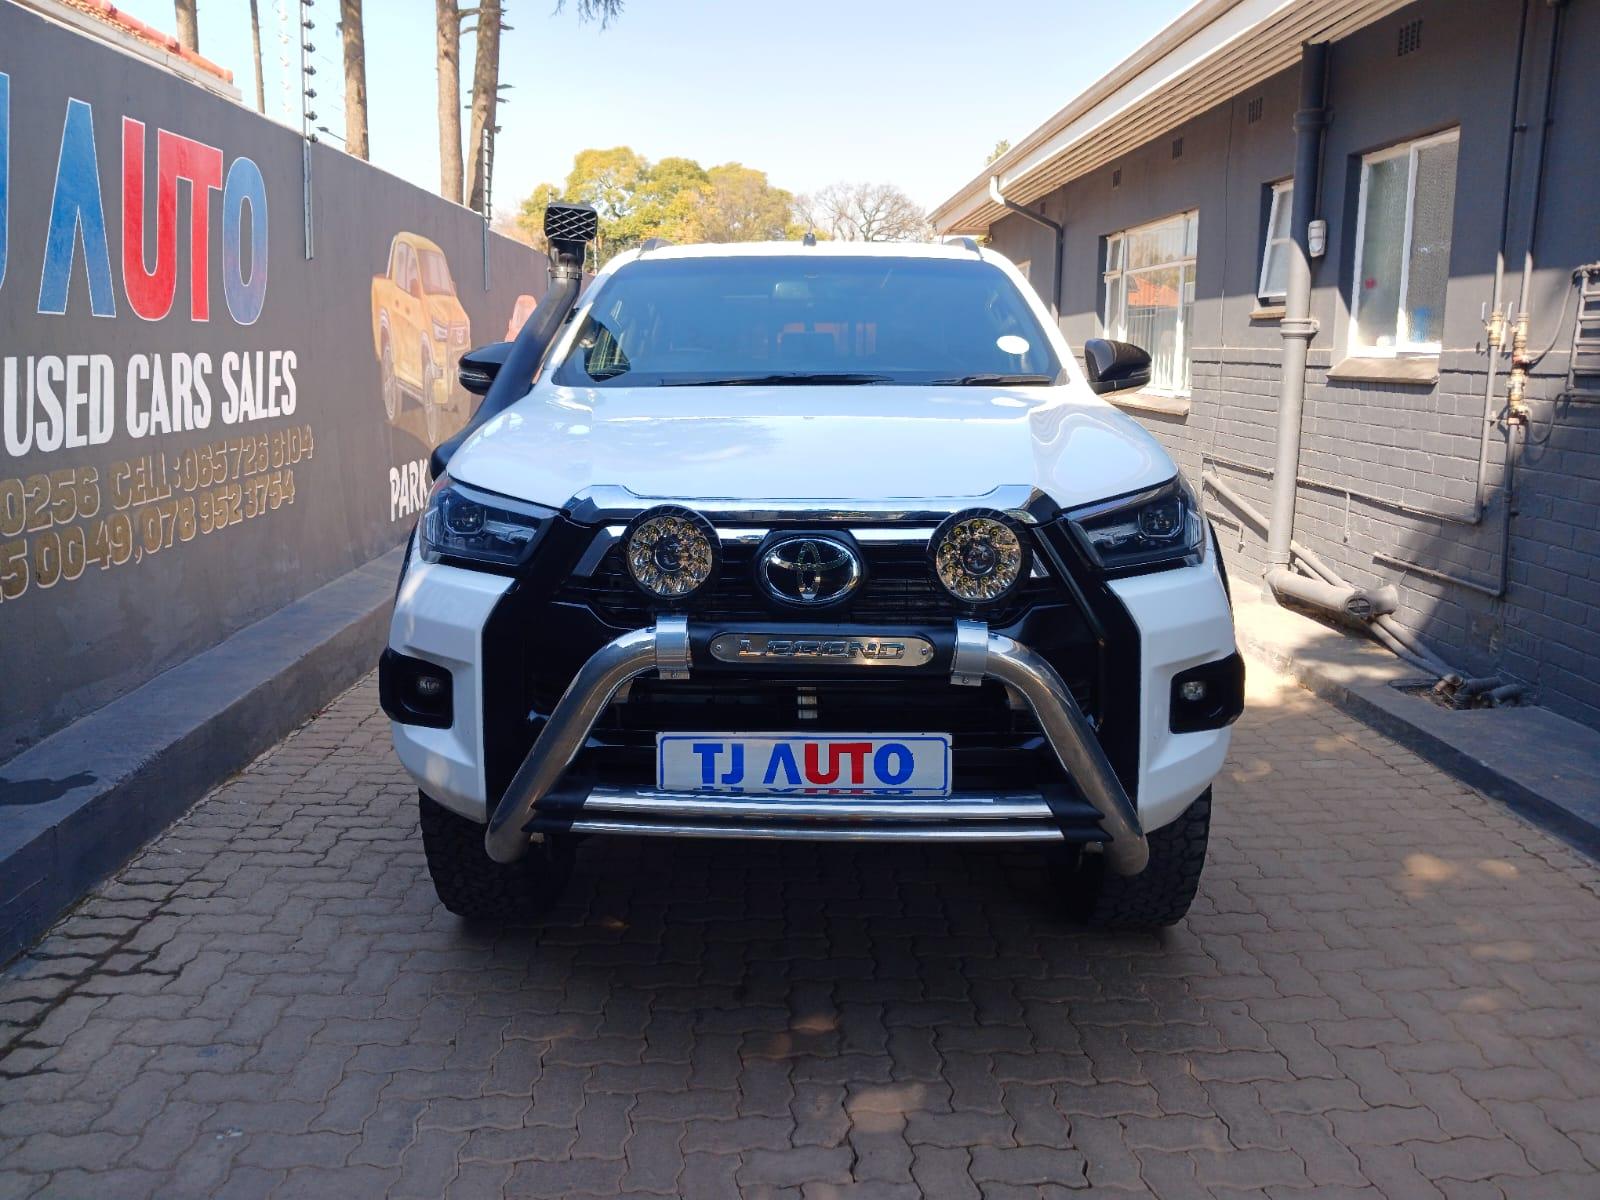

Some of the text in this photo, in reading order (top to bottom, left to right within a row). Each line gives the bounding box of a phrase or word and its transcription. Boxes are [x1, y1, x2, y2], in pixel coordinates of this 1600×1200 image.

[37, 97, 269, 326] AUTO
[4, 350, 298, 457] USED CARS SALES
[389, 458, 429, 522] PARK
[738, 639, 906, 660] LEGEND
[692, 743, 915, 785] TJ AUTO
